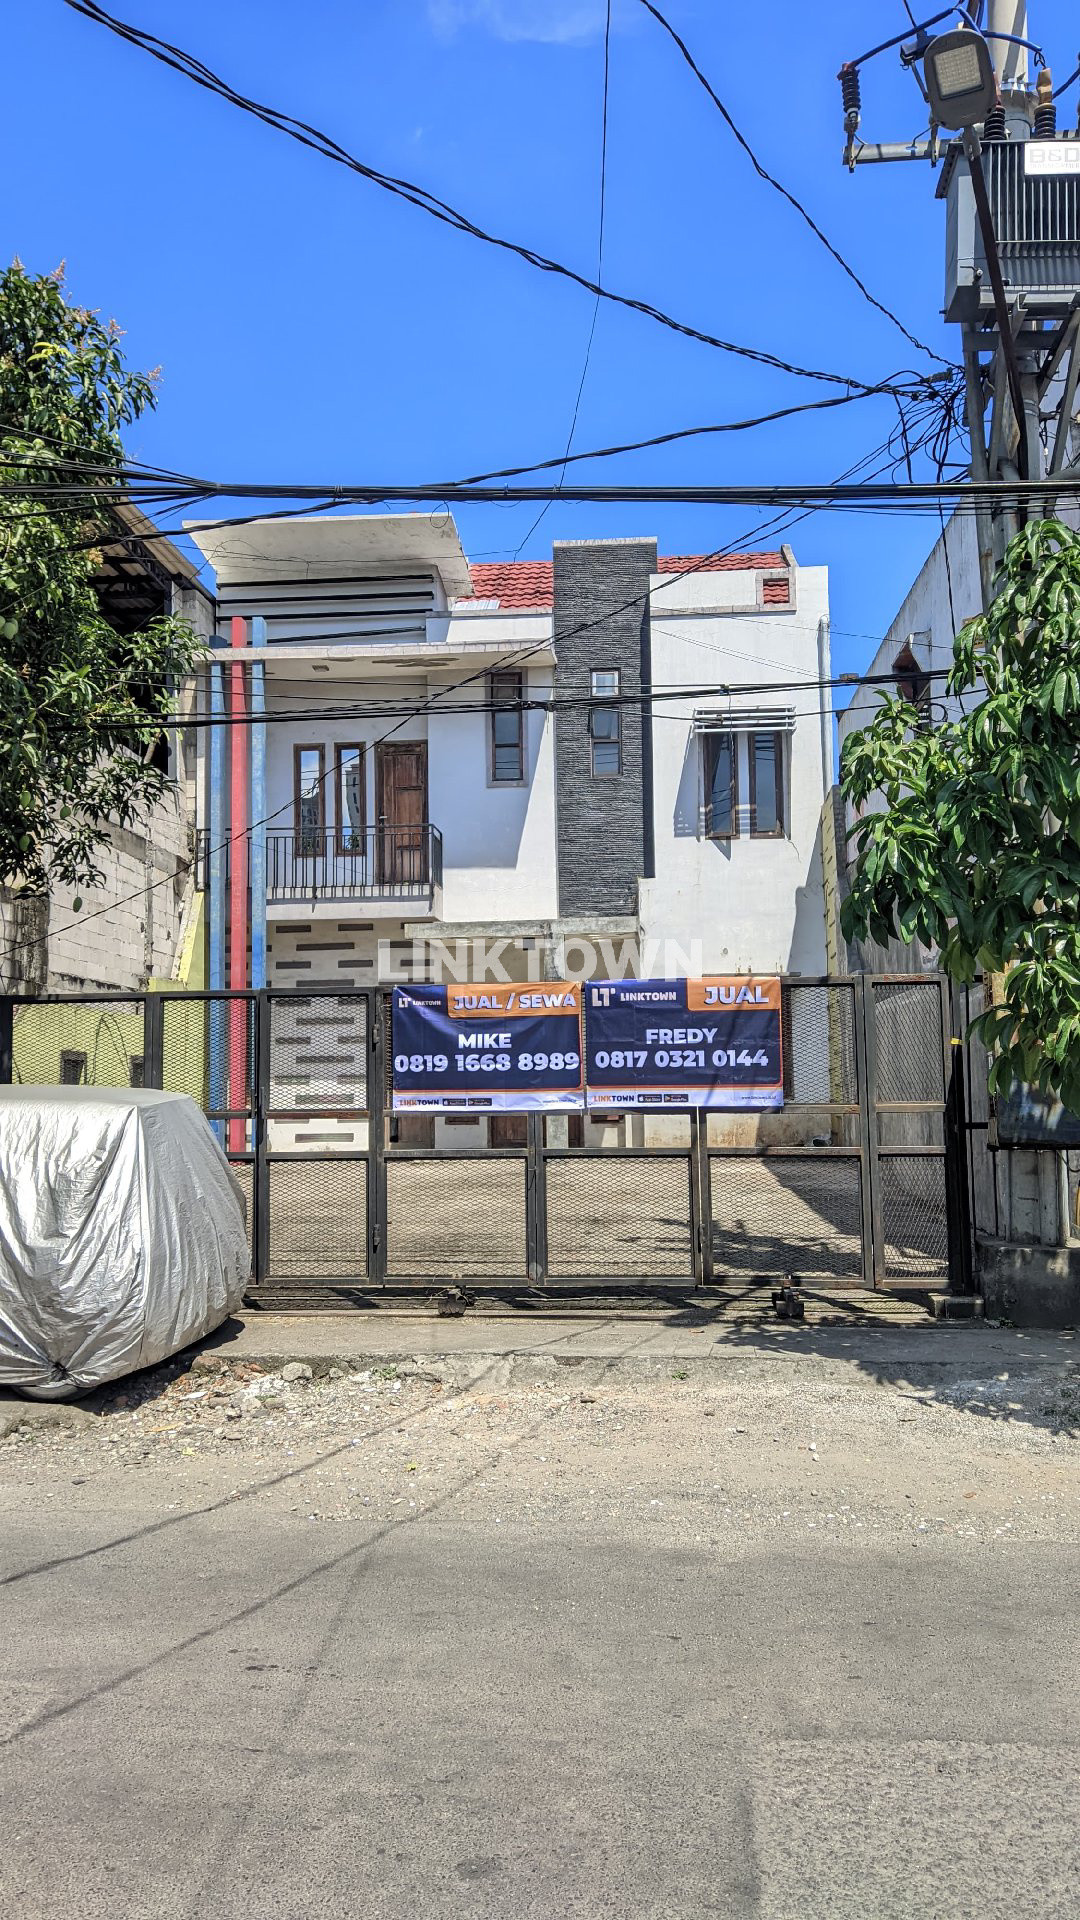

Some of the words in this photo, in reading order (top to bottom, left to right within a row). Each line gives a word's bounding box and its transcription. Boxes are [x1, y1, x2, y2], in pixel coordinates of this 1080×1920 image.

[453, 995, 503, 1010] JUAL
[505, 992, 516, 1010] /
[518, 993, 577, 1009] SEWA
[620, 991, 677, 1002] LINKTOWN
[704, 985, 769, 1005] JUAL
[458, 1033, 512, 1049] MIKE
[645, 1027, 718, 1045] FREDY
[394, 1054, 449, 1073] 0819
[454, 1053, 512, 1072] 1668
[517, 1052, 580, 1071] 8989
[595, 1050, 648, 1068] 0817
[654, 1050, 705, 1068] 0321
[712, 1049, 769, 1067] 0144
[399, 1099, 440, 1107] LINKTOWN
[593, 1094, 635, 1102] LINKTOWN
